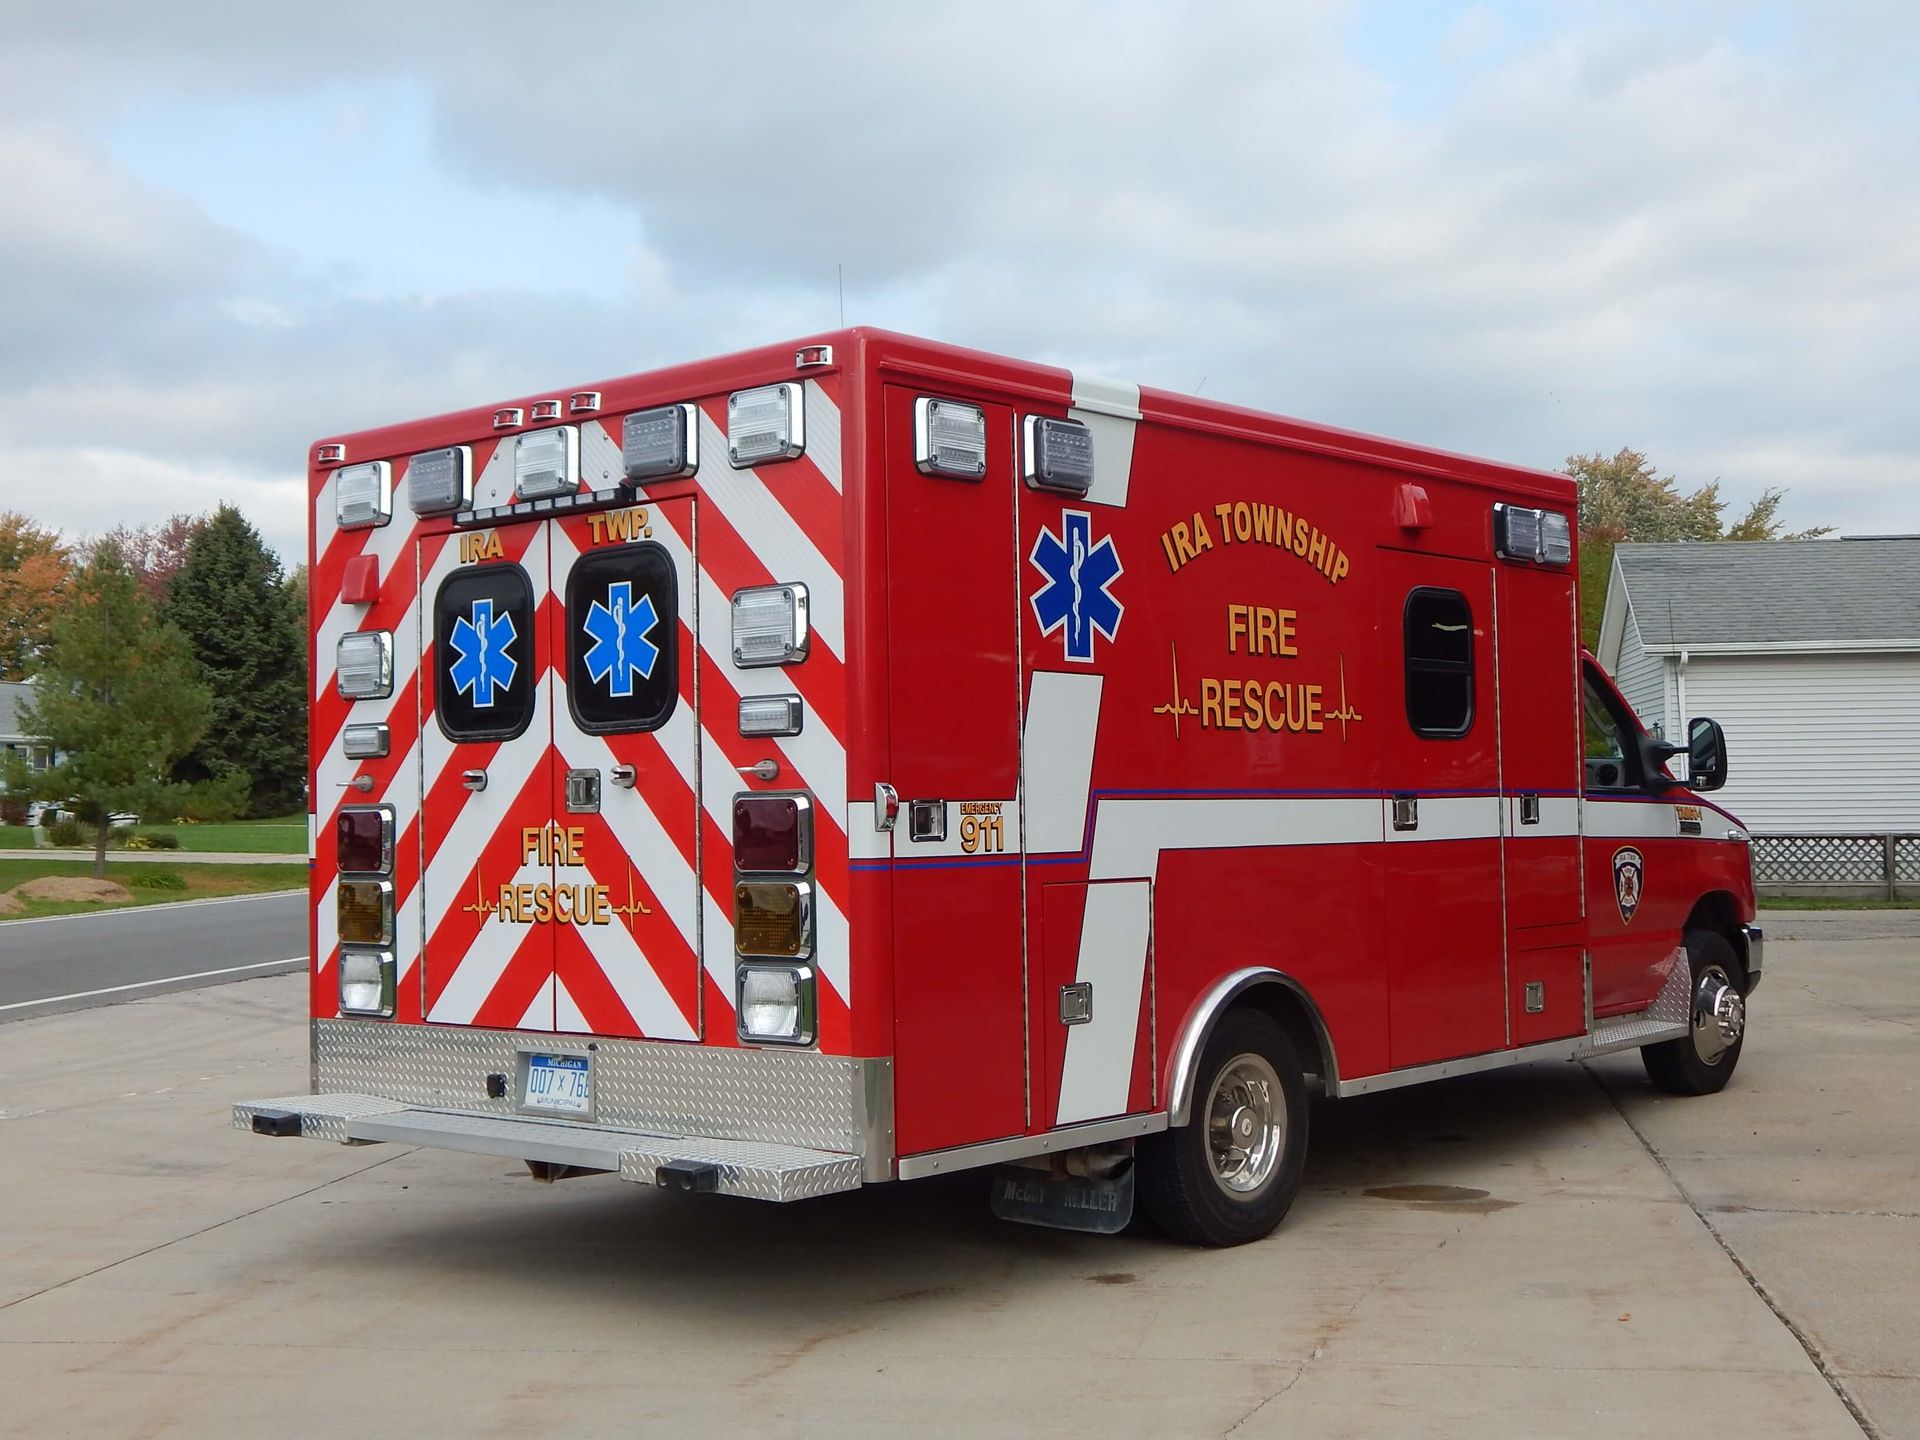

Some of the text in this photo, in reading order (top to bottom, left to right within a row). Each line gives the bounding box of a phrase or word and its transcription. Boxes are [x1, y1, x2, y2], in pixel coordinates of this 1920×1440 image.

[460, 507, 653, 563] IRA TWP.
[1160, 501, 1350, 585] IRA TOWNSHIP
[1227, 603, 1298, 657] FIRE
[1201, 677, 1324, 733] RESCUE
[960, 802, 1003, 815] EMERGENCY
[521, 826, 585, 866] FIRE
[960, 815, 1004, 854] 911
[498, 883, 611, 925] RESCUE
[530, 1068, 555, 1095] 007
[557, 1074, 565, 1092] X
[547, 1058, 583, 1069] MICHIGAN
[541, 1096, 577, 1107] MUNICIPAL
